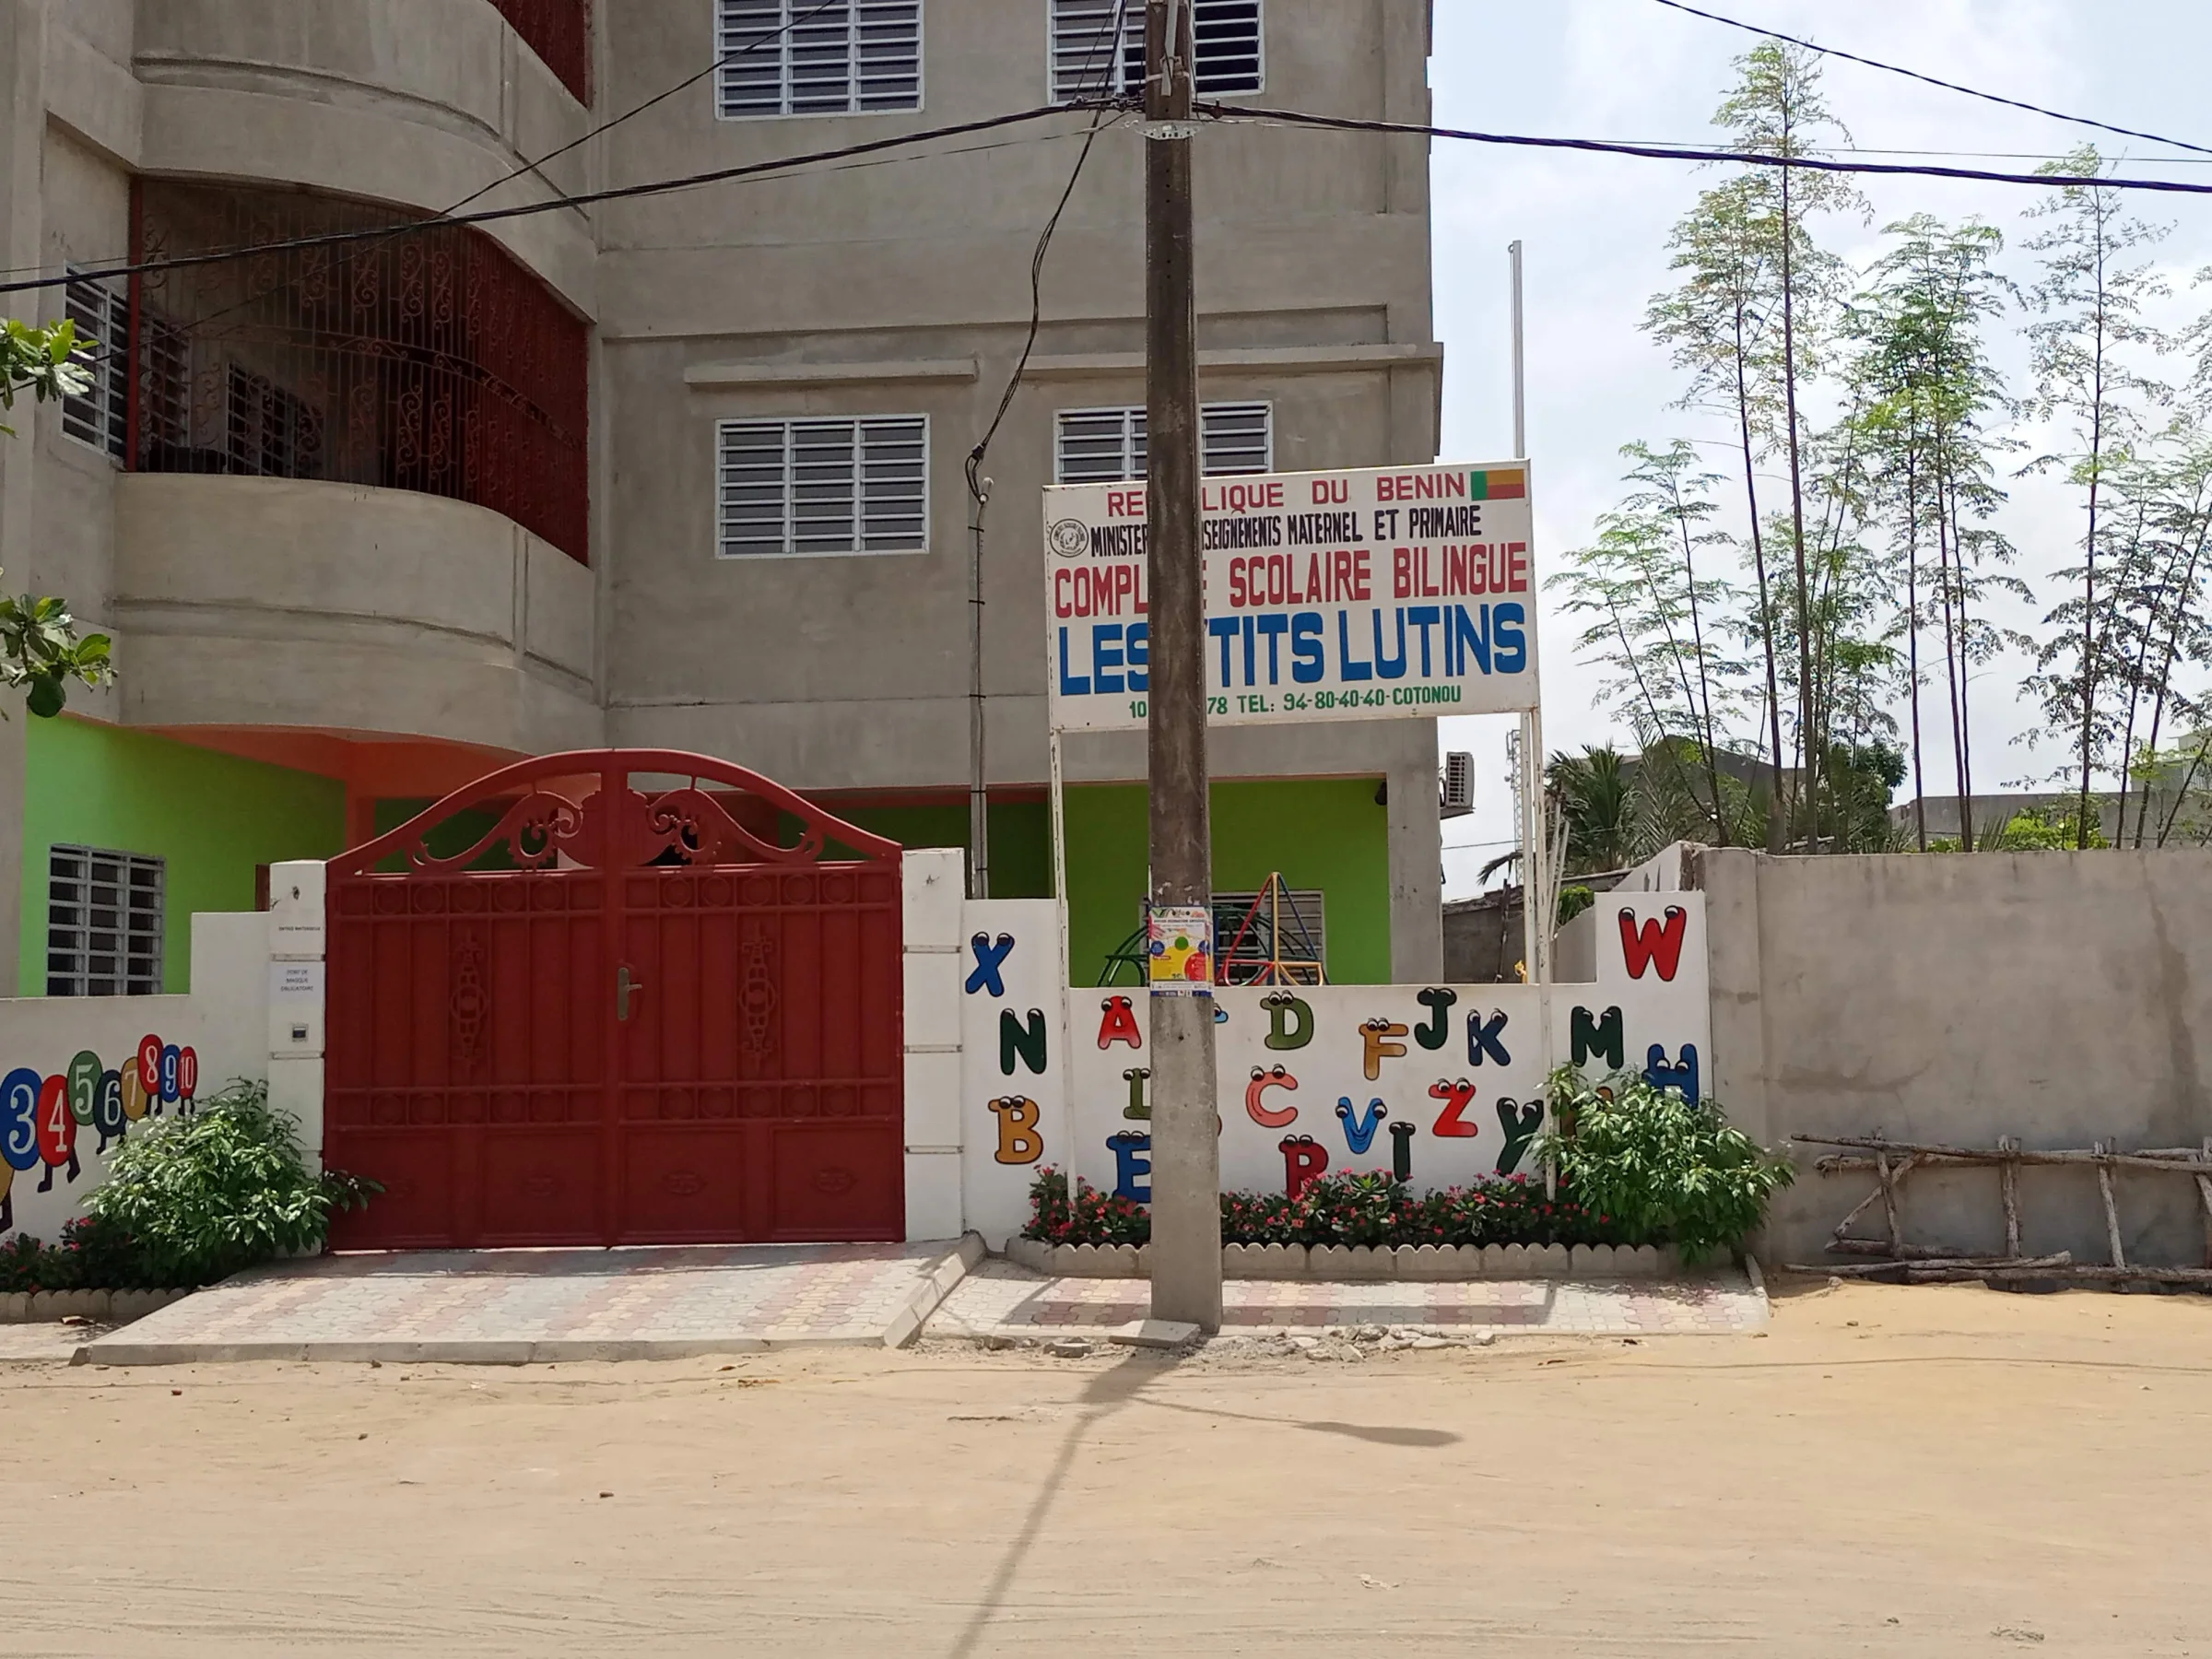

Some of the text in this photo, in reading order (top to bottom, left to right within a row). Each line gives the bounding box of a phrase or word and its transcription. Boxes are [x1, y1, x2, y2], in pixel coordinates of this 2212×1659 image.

[1108, 473, 1465, 517] RELIQUE DU BENIN
[1288, 512, 1363, 546] MATERNEL
[1374, 509, 1399, 541] ET
[1409, 505, 1482, 539] PRIMAIRE
[1055, 542, 1527, 618] COMPL SCOLAIRE BILINGUE
[1059, 622, 1149, 696] LES
[1338, 603, 1526, 682] LUTINS
[1237, 694, 1275, 714] TEL:
[965, 932, 1015, 997] X
[1618, 905, 1687, 982] W
[1000, 1008, 1047, 1076] N
[1098, 995, 1142, 1050] A
[1260, 990, 1313, 1050] D
[1359, 1018, 1408, 1080] F
[1414, 988, 1457, 1050] J
[1466, 1009, 1511, 1066] K
[1571, 1006, 1624, 1069] M
[8, 1045, 194, 1154] 3 4 5 6 7 8 9 10
[1246, 1065, 1298, 1127] C
[1335, 1097, 1387, 1154] V
[1429, 1078, 1477, 1136] Z
[988, 1096, 1043, 1165] B
[1496, 1097, 1544, 1177] Y
